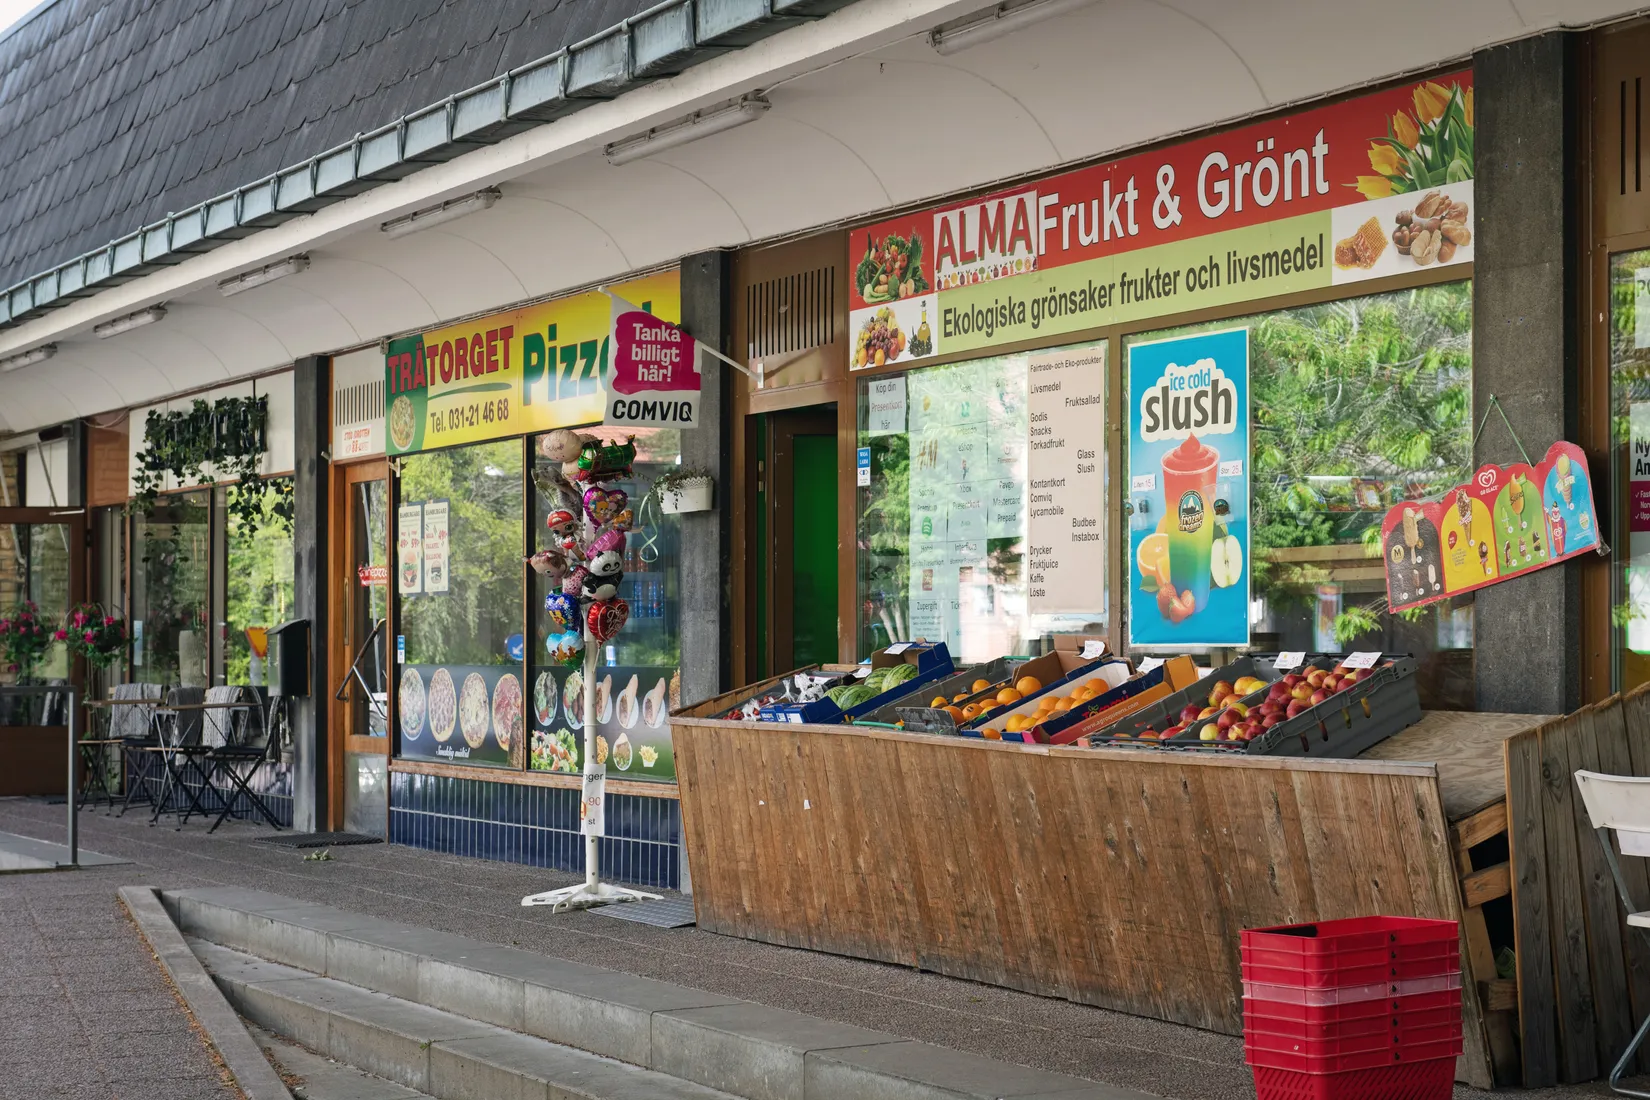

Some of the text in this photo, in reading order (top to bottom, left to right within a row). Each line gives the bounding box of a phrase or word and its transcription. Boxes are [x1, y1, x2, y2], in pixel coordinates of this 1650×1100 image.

[935, 127, 1330, 273] ALMA Frukt & Grönt
[942, 232, 1325, 340] Ekologiska grönsaker frukter och livsmedel
[632, 322, 681, 343] Tanka
[388, 325, 515, 395] TRÄTORGET
[631, 344, 680, 366] billigt
[1030, 356, 1102, 373] Fairtrade- och Eko-produkter
[637, 364, 672, 382] här!
[1169, 368, 1211, 391] ice cold
[888, 381, 897, 391] din
[1030, 381, 1061, 394] Livsmedel
[1065, 393, 1101, 407] Fruktsallad
[1145, 378, 1232, 433] slush
[430, 397, 510, 434] Tel. 031-21 46 68
[612, 399, 693, 422] COMVIQ
[1030, 411, 1048, 422] Godis
[1030, 426, 1052, 436] Snacks
[1077, 449, 1095, 459] Glass
[1077, 463, 1095, 474] Slush
[1030, 477, 1066, 489] Kontantkort
[1030, 492, 1053, 503] Comviq
[997, 512, 1017, 523] Prepaid
[1030, 506, 1065, 519] Lycamobile
[1072, 517, 1097, 528] Budbee
[1071, 532, 1100, 542] Instabox
[1029, 545, 1053, 557] Drycker
[1029, 559, 1059, 571] Fruktjuice
[1029, 573, 1045, 583] Kaffe
[1029, 587, 1046, 597] Löste
